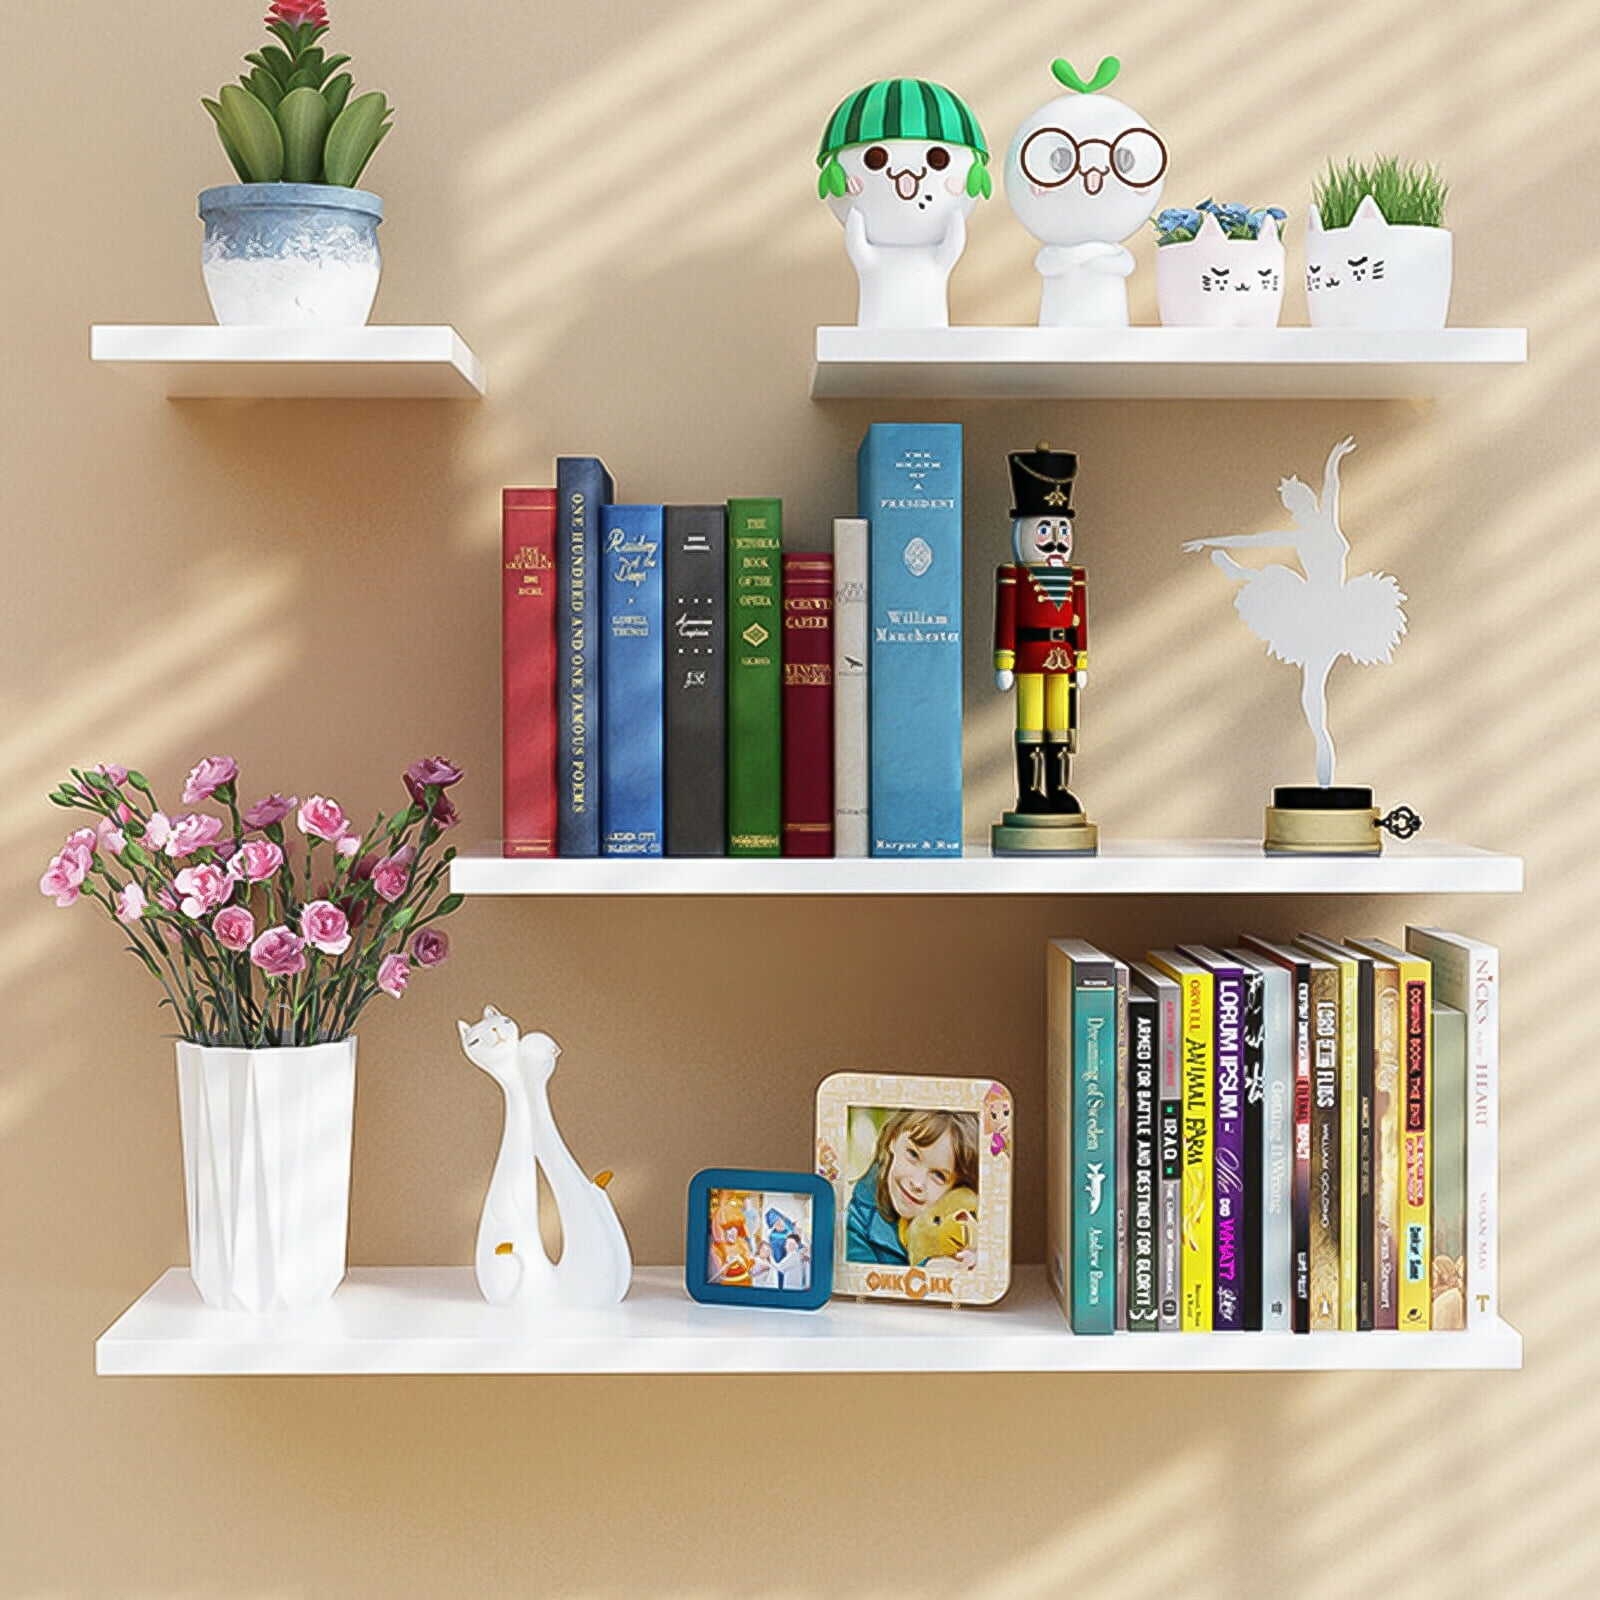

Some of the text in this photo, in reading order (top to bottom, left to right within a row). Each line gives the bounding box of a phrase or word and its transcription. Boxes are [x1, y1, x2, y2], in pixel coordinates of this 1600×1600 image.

[880, 499, 954, 508] PRESIDENT
[743, 557, 769, 568] BOOK
[875, 628, 960, 642] Manchester
[887, 611, 948, 625] William
[571, 493, 585, 813] ONE HUNDRED AND ONE FAMOUS POEMS
[1190, 980, 1202, 1032] ORWELL
[1219, 980, 1239, 1052] LORUM
[1137, 1017, 1152, 1060] ARMED
[1081, 1017, 1106, 1151] Dreaming of Sweden
[1137, 1063, 1152, 1088] FOR
[1185, 1037, 1207, 1166] ANIMAL FARM
[1219, 1055, 1239, 1119] IPSUM
[1475, 1063, 1489, 1127] HEART
[1137, 1091, 1152, 1136] BATTLE
[1137, 1139, 1152, 1166] AND
[1216, 1147, 1243, 1193] She
[1320, 1123, 1331, 1228] WILLIAM GOLDING
[1137, 1169, 1152, 1229] DESTINED
[1269, 1157, 1286, 1216] Wrong
[1088, 1227, 1104, 1305] Andrew Brown
[1137, 1231, 1152, 1256] FOR
[1219, 1218, 1236, 1281] WHAT?
